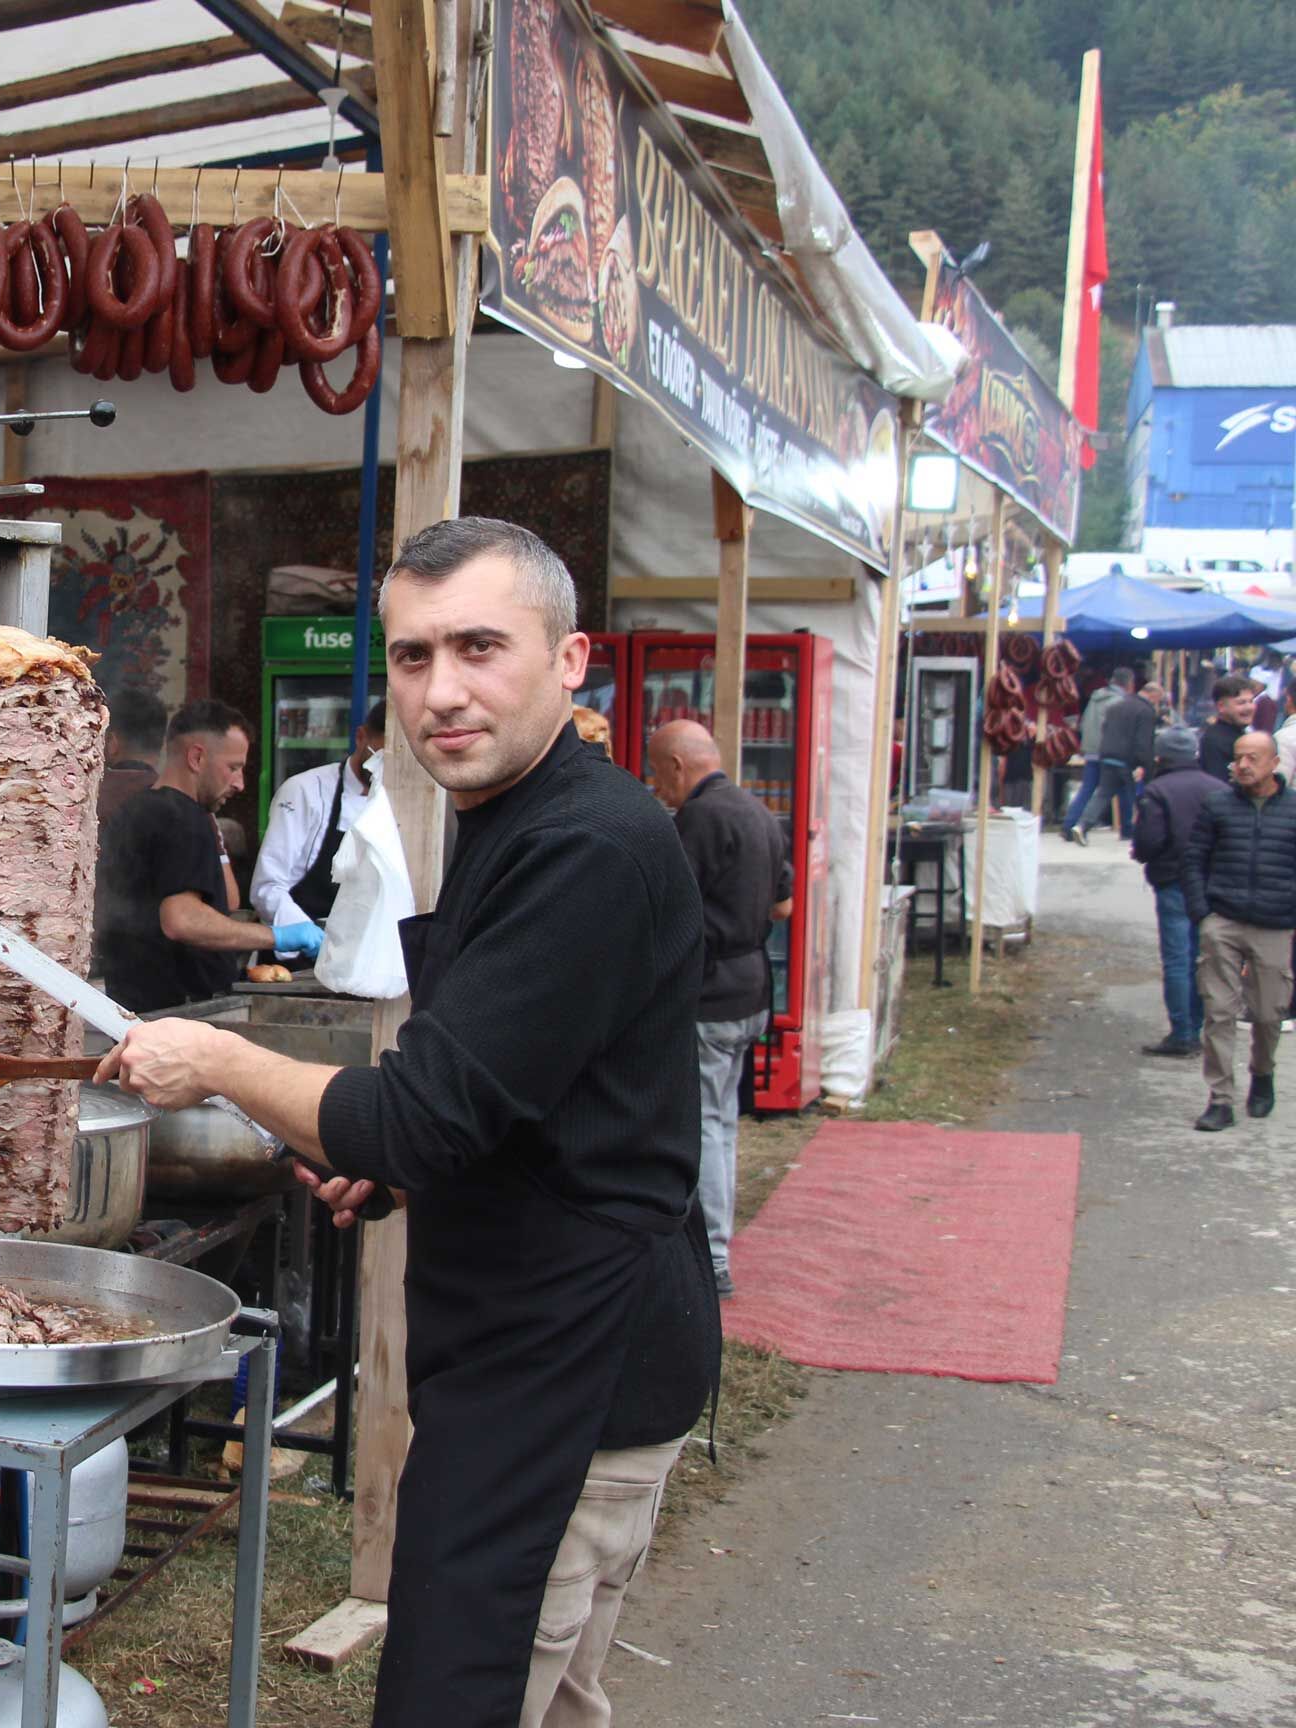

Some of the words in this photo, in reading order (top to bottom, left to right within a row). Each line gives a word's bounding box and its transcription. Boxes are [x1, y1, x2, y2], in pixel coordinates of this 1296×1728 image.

[636, 125, 744, 377] BEREKET
[648, 318, 662, 381] ET
[662, 325, 696, 410] DÖNER
[304, 626, 353, 649] fuse
